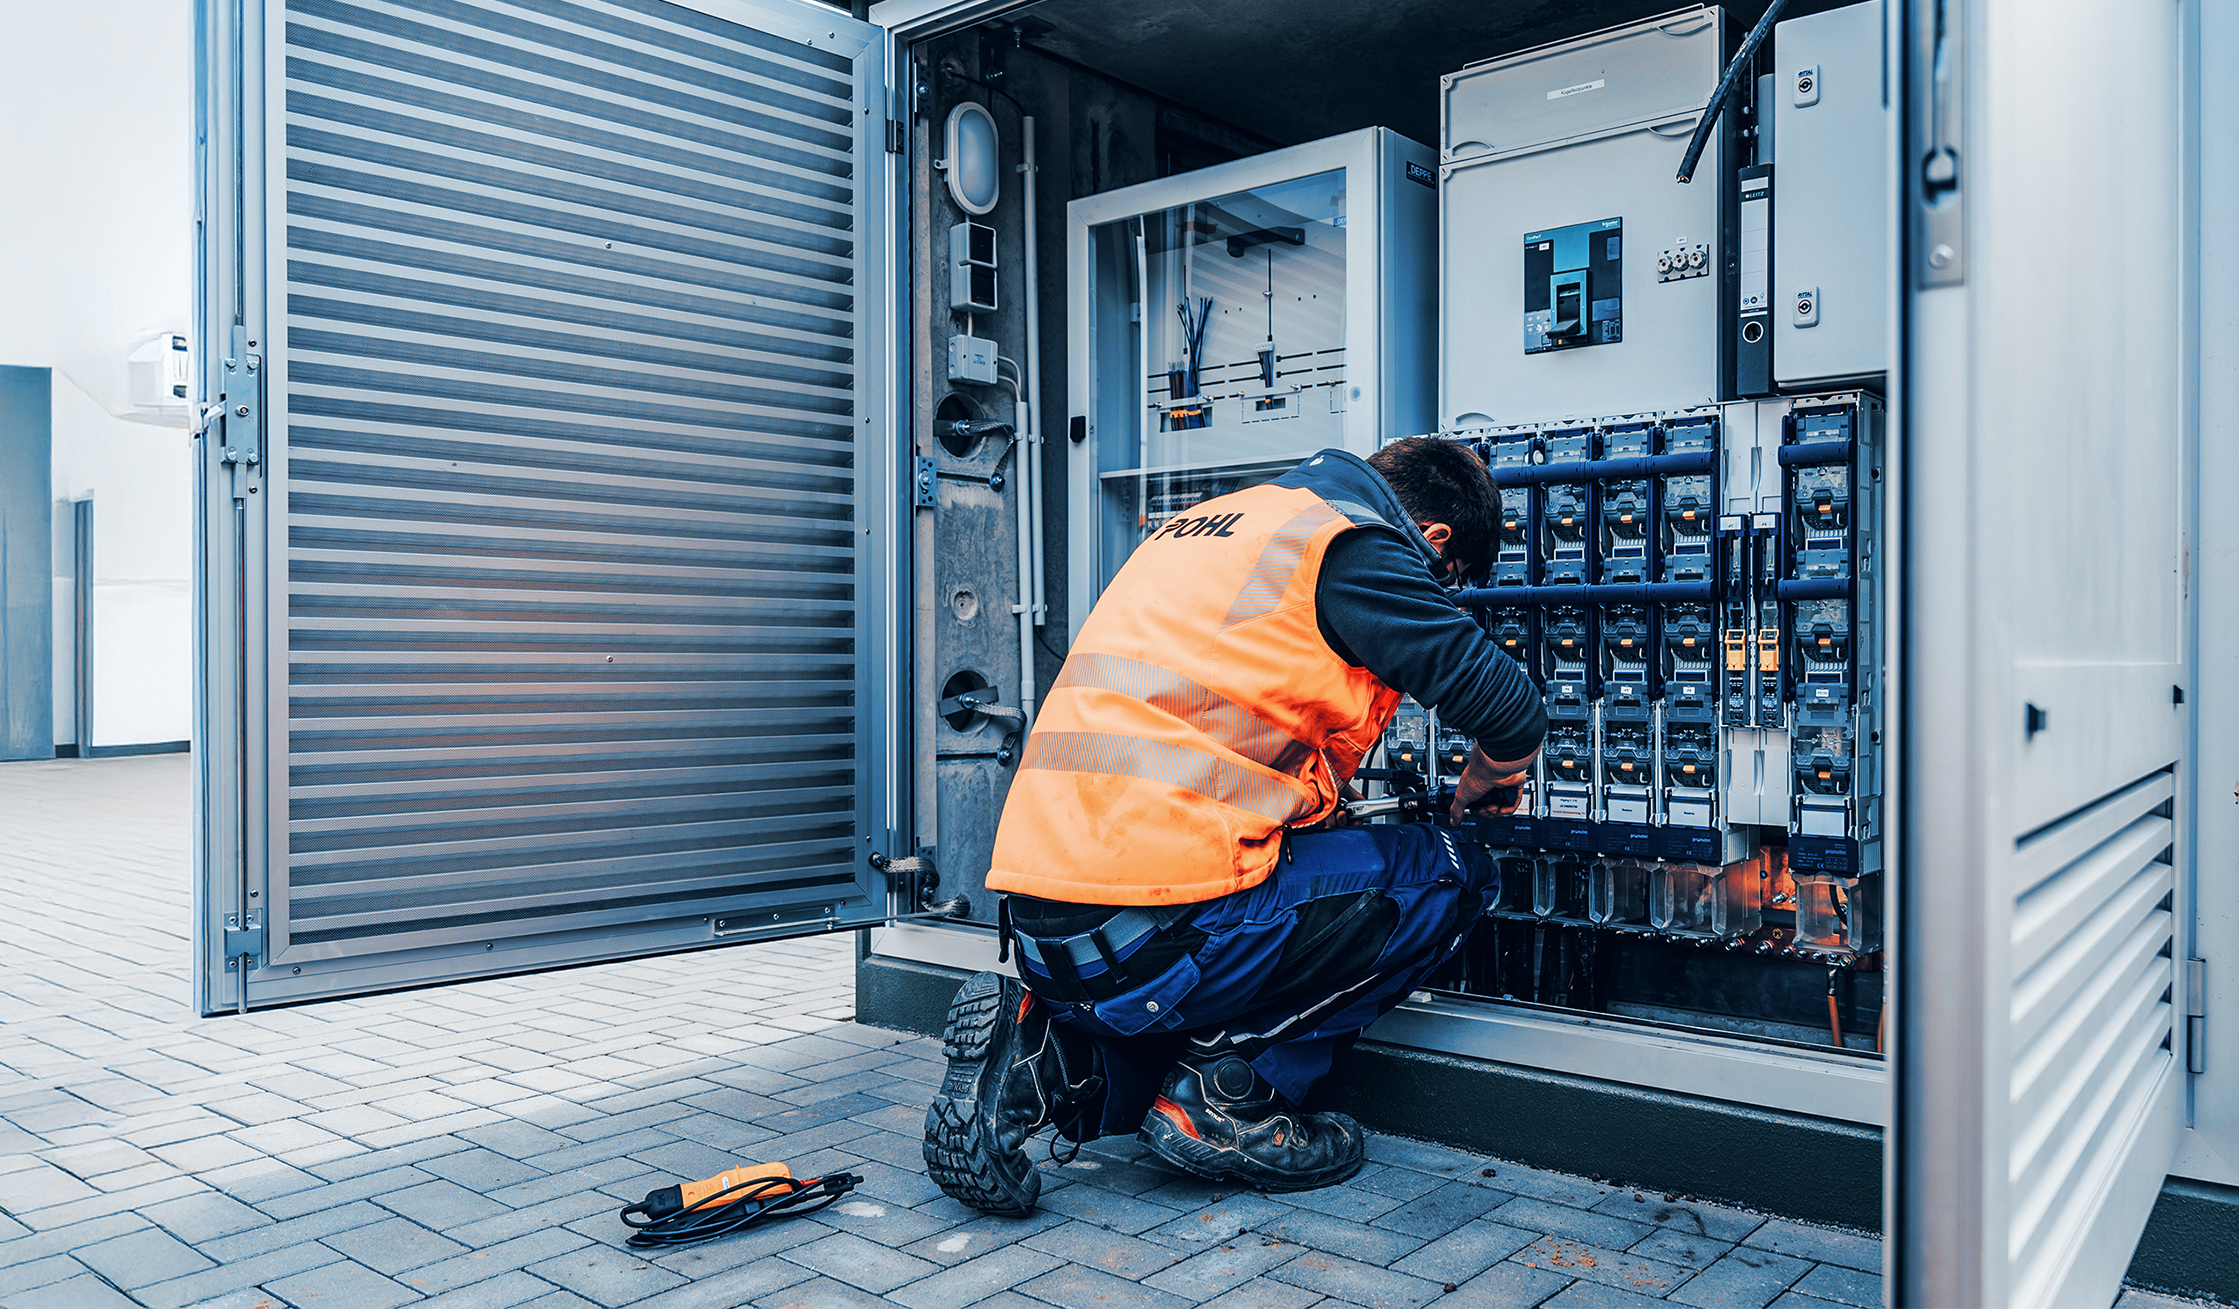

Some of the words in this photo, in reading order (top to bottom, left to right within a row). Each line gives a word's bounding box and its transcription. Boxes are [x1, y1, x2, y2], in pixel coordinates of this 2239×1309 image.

[1410, 164, 1432, 181] DEPPE
[1750, 191, 1764, 199] LEITZ
[1154, 513, 1245, 541] POHL
